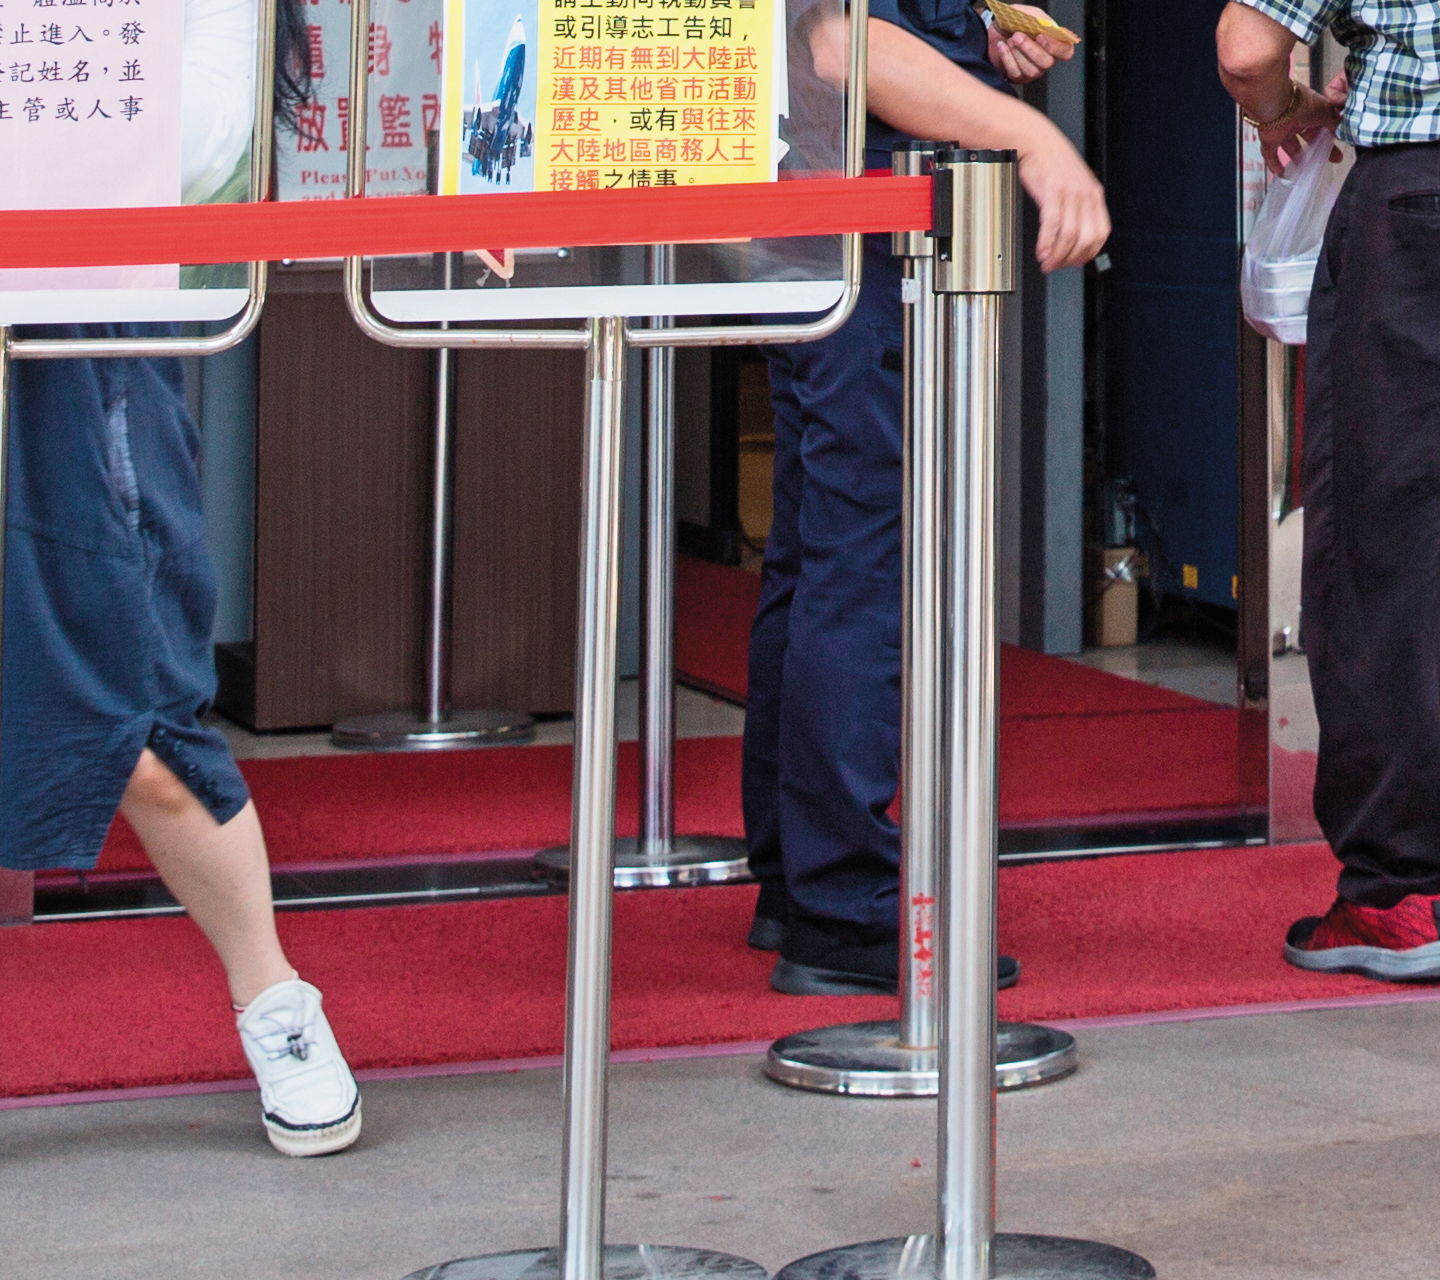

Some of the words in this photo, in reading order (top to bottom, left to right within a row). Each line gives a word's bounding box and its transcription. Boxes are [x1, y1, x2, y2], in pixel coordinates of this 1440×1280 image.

[552, 45, 758, 70] 近期有無到大陸武
[551, 76, 757, 101] 漢及其他省市活動
[549, 137, 756, 163] 大陸地區商務人士
